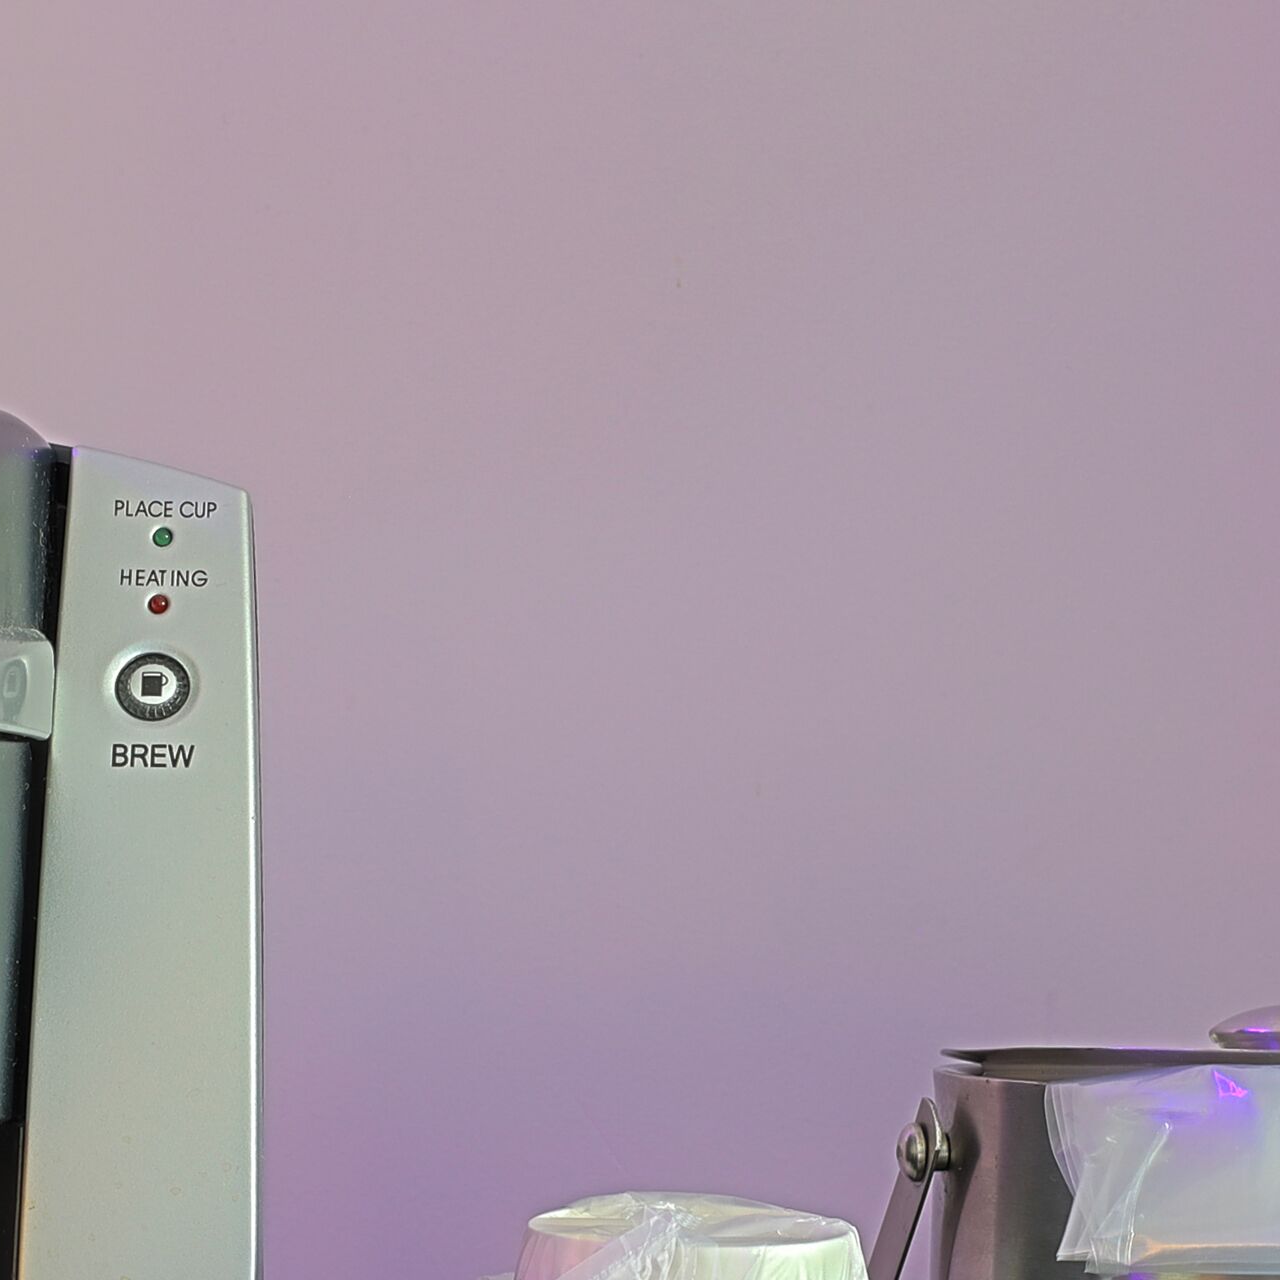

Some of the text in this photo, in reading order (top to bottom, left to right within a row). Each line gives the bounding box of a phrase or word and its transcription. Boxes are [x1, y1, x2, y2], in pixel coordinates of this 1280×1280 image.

[114, 500, 217, 518] PLACE CUP
[120, 569, 208, 587] HEATING
[111, 743, 195, 768] BREW
